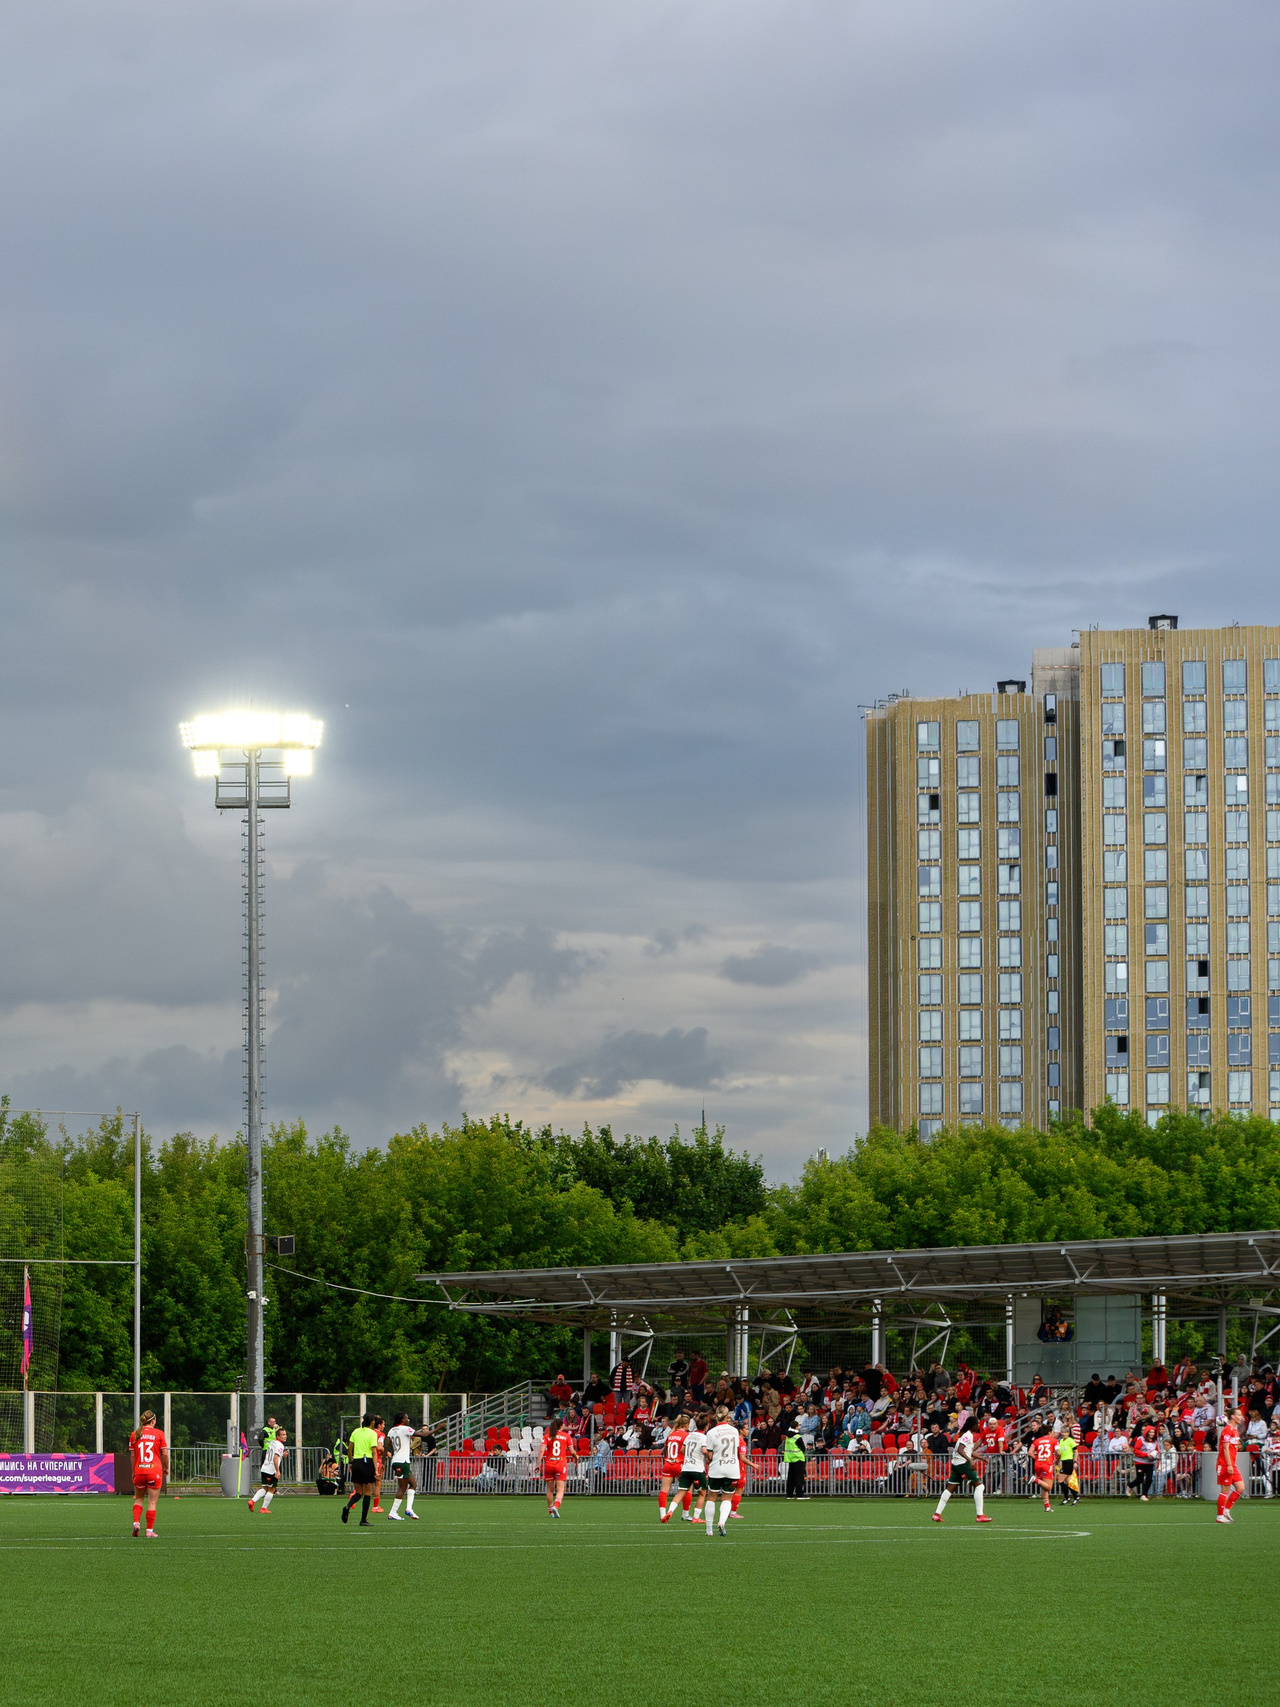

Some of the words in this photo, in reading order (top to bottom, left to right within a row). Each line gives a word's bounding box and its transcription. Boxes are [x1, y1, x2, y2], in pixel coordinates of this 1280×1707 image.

[138, 1441, 155, 1463] 13
[552, 1440, 561, 1457] 8
[667, 1441, 679, 1459] 10
[721, 1436, 737, 1458] 21
[1037, 1443, 1051, 1459] 23
[27, 1461, 38, 1471] НА
[40, 1461, 83, 1471] СУПЕРЛИГУ
